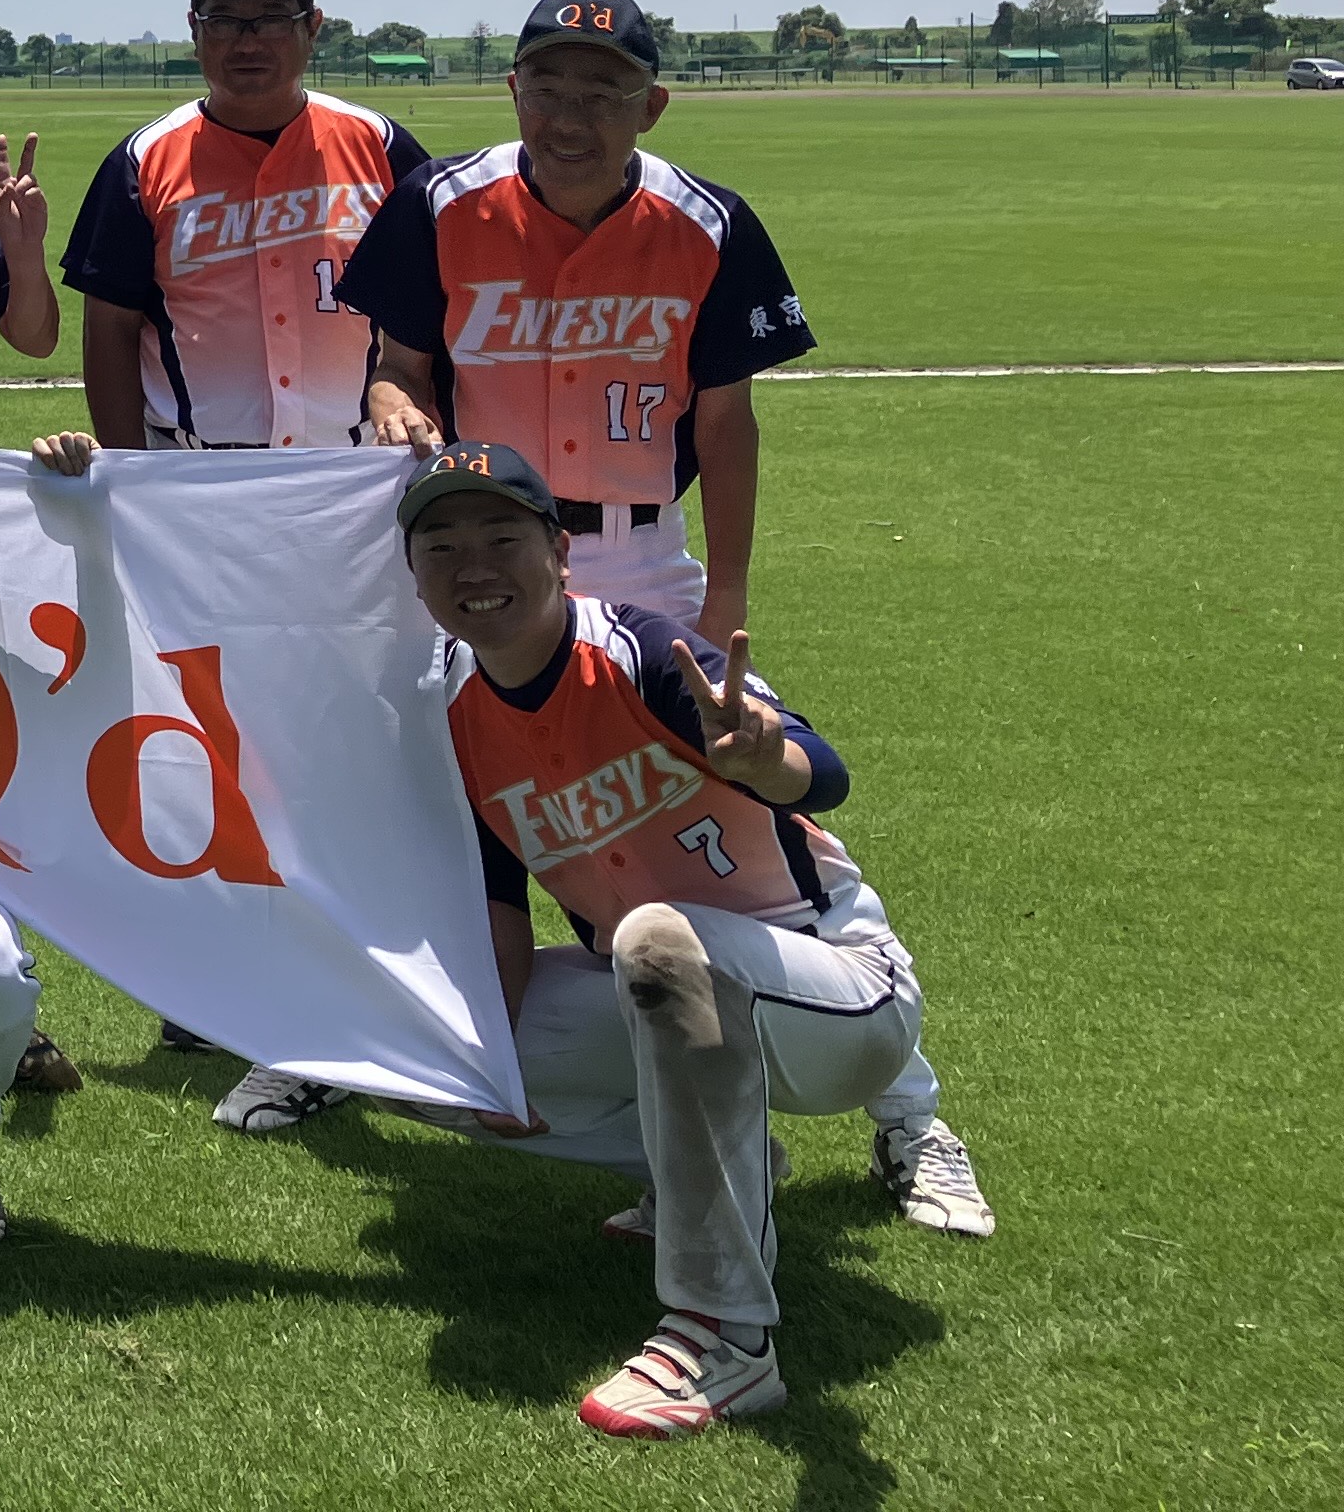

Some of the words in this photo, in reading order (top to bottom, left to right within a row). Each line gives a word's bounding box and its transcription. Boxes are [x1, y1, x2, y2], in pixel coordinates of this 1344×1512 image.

[555, 2, 614, 32] Q'd
[450, 278, 692, 366] ENESYS
[605, 380, 666, 442] 17
[481, 742, 704, 875] ENESYS
[674, 815, 738, 879] 7
